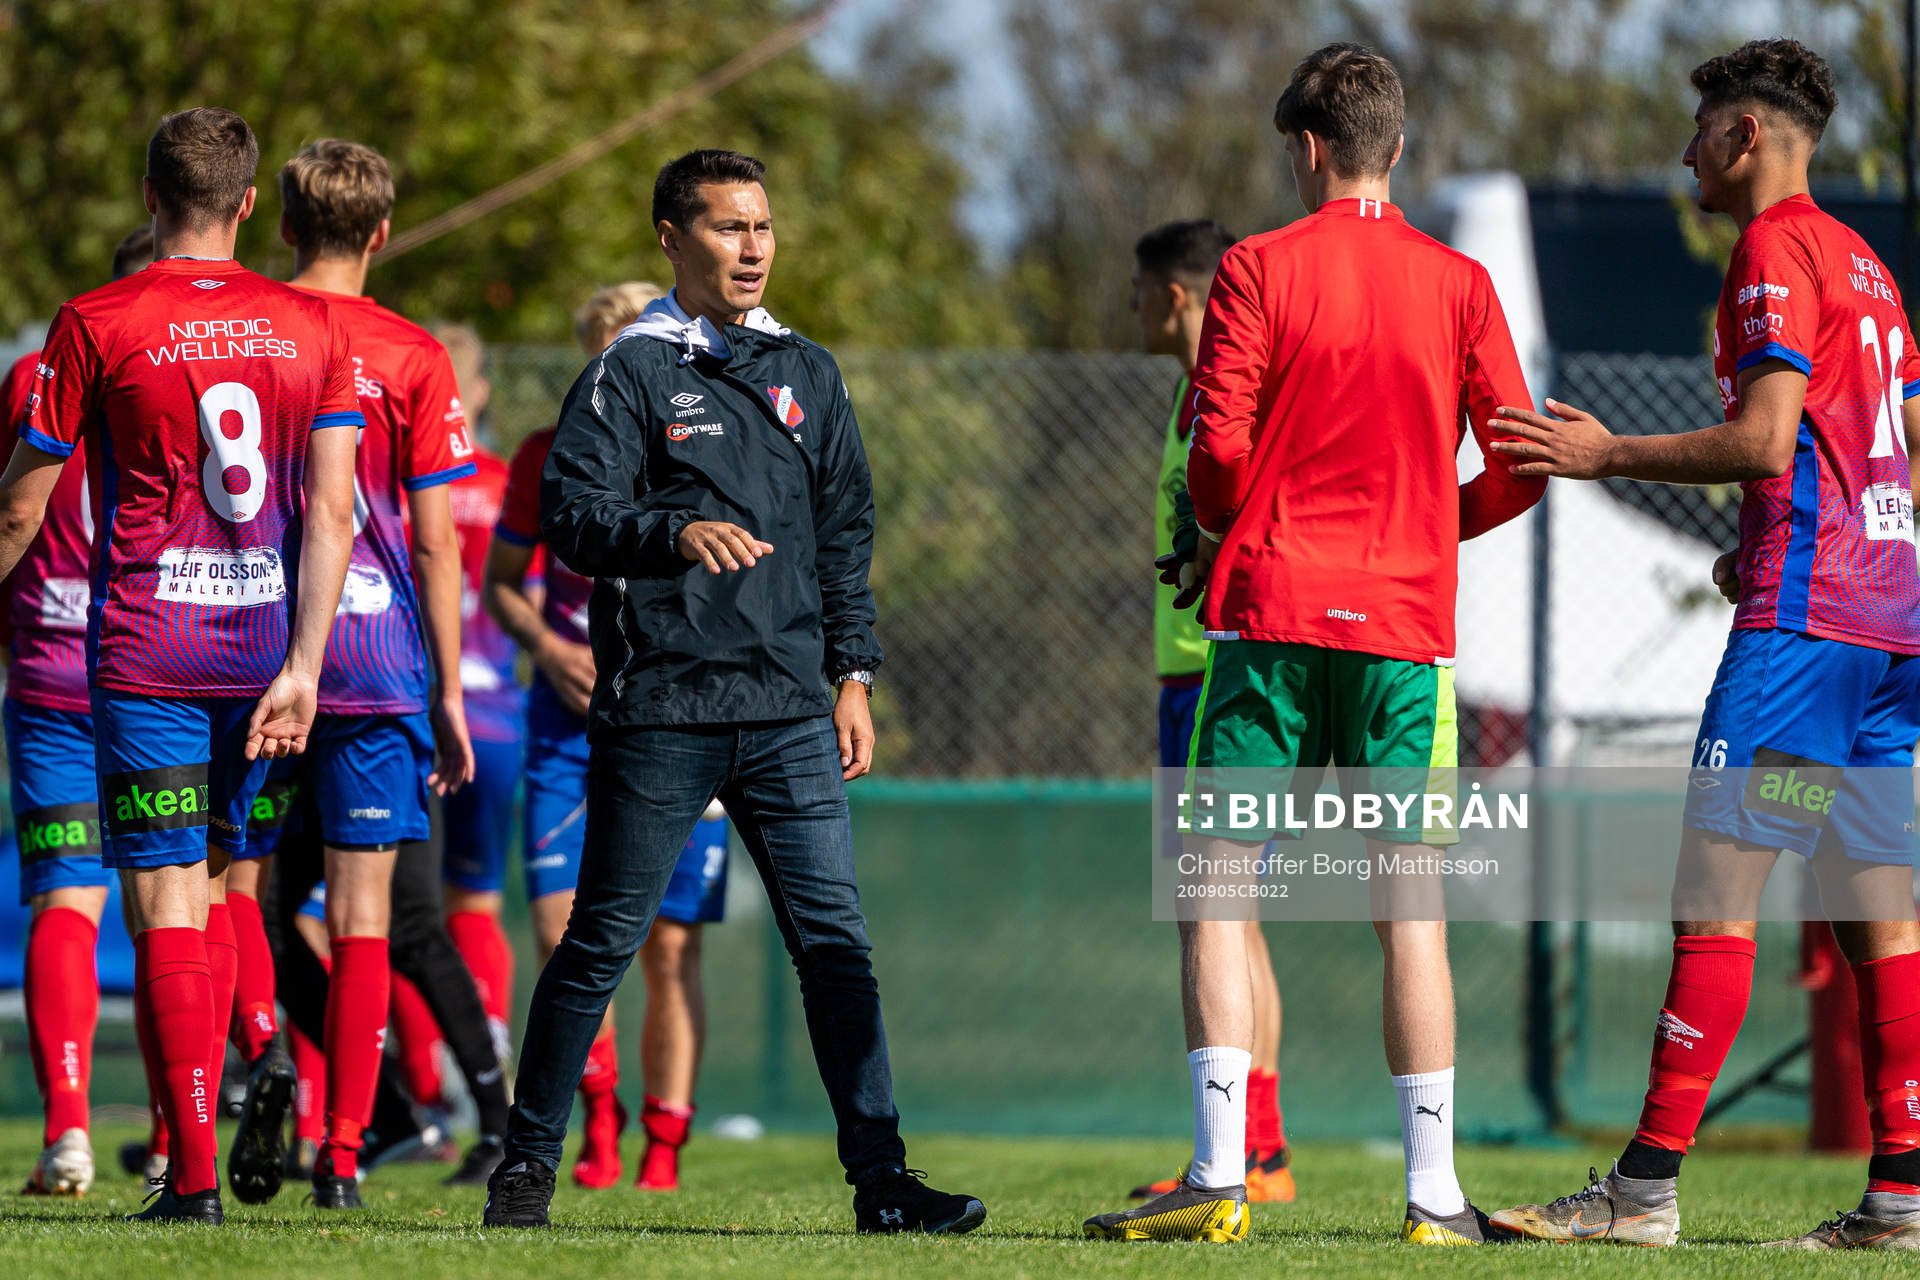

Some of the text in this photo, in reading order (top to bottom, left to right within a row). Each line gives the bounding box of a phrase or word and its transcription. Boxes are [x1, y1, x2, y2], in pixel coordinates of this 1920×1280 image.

[1738, 282, 1790, 304] Bildeve
[168, 318, 273, 341] NORDIC
[146, 338, 298, 366] WELLNESS
[675, 407, 705, 418] umbro
[672, 423, 724, 437] SPORTWARE
[200, 381, 267, 523] 8
[1876, 497, 1902, 516] LEI
[172, 562, 203, 579] LEIF
[168, 581, 245, 597] MÅLERI
[1327, 608, 1367, 622] umbro
[1696, 737, 1729, 772] 26
[191, 1067, 208, 1123] umbro
